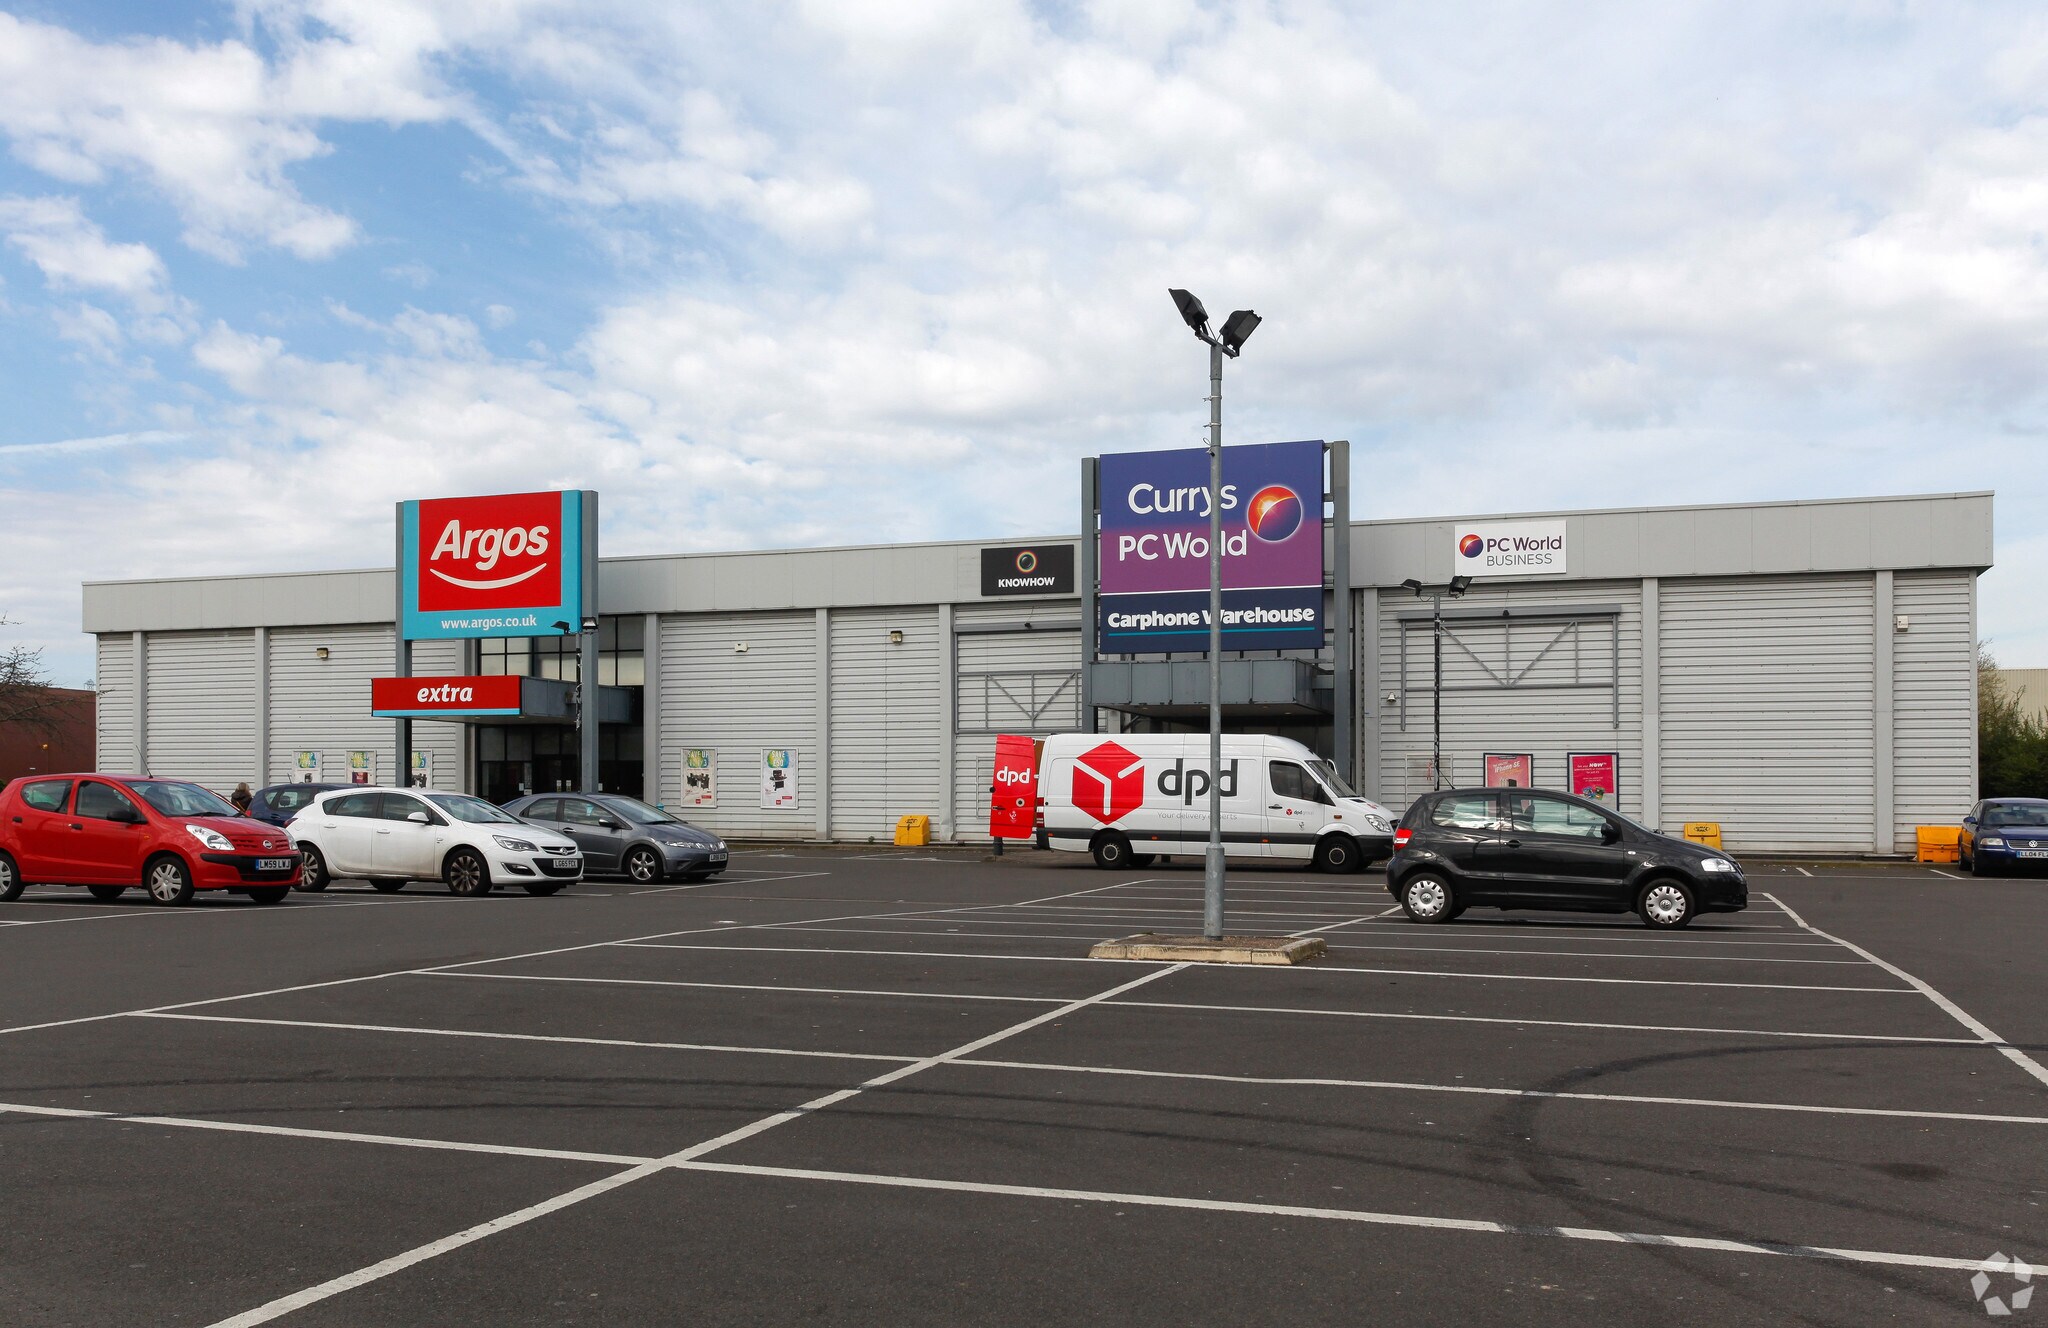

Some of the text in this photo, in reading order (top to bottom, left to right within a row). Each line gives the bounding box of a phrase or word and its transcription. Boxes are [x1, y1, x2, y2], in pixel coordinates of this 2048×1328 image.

[1128, 483, 1238, 517] Currys
[430, 519, 550, 571] Argos
[1119, 529, 1247, 561] PC Wold
[1487, 535, 1562, 552] PC World
[1486, 553, 1553, 567] BUSINESS
[998, 576, 1055, 588] KNOWHOW
[441, 614, 537, 631] www.argos.co.uk
[1107, 606, 1315, 630] Carphone Warehouse
[417, 683, 473, 703] extra
[996, 765, 1031, 787] dpd
[1157, 758, 1239, 806] dpd
[1176, 812, 1206, 820] delivery
[259, 860, 277, 869] LM59
